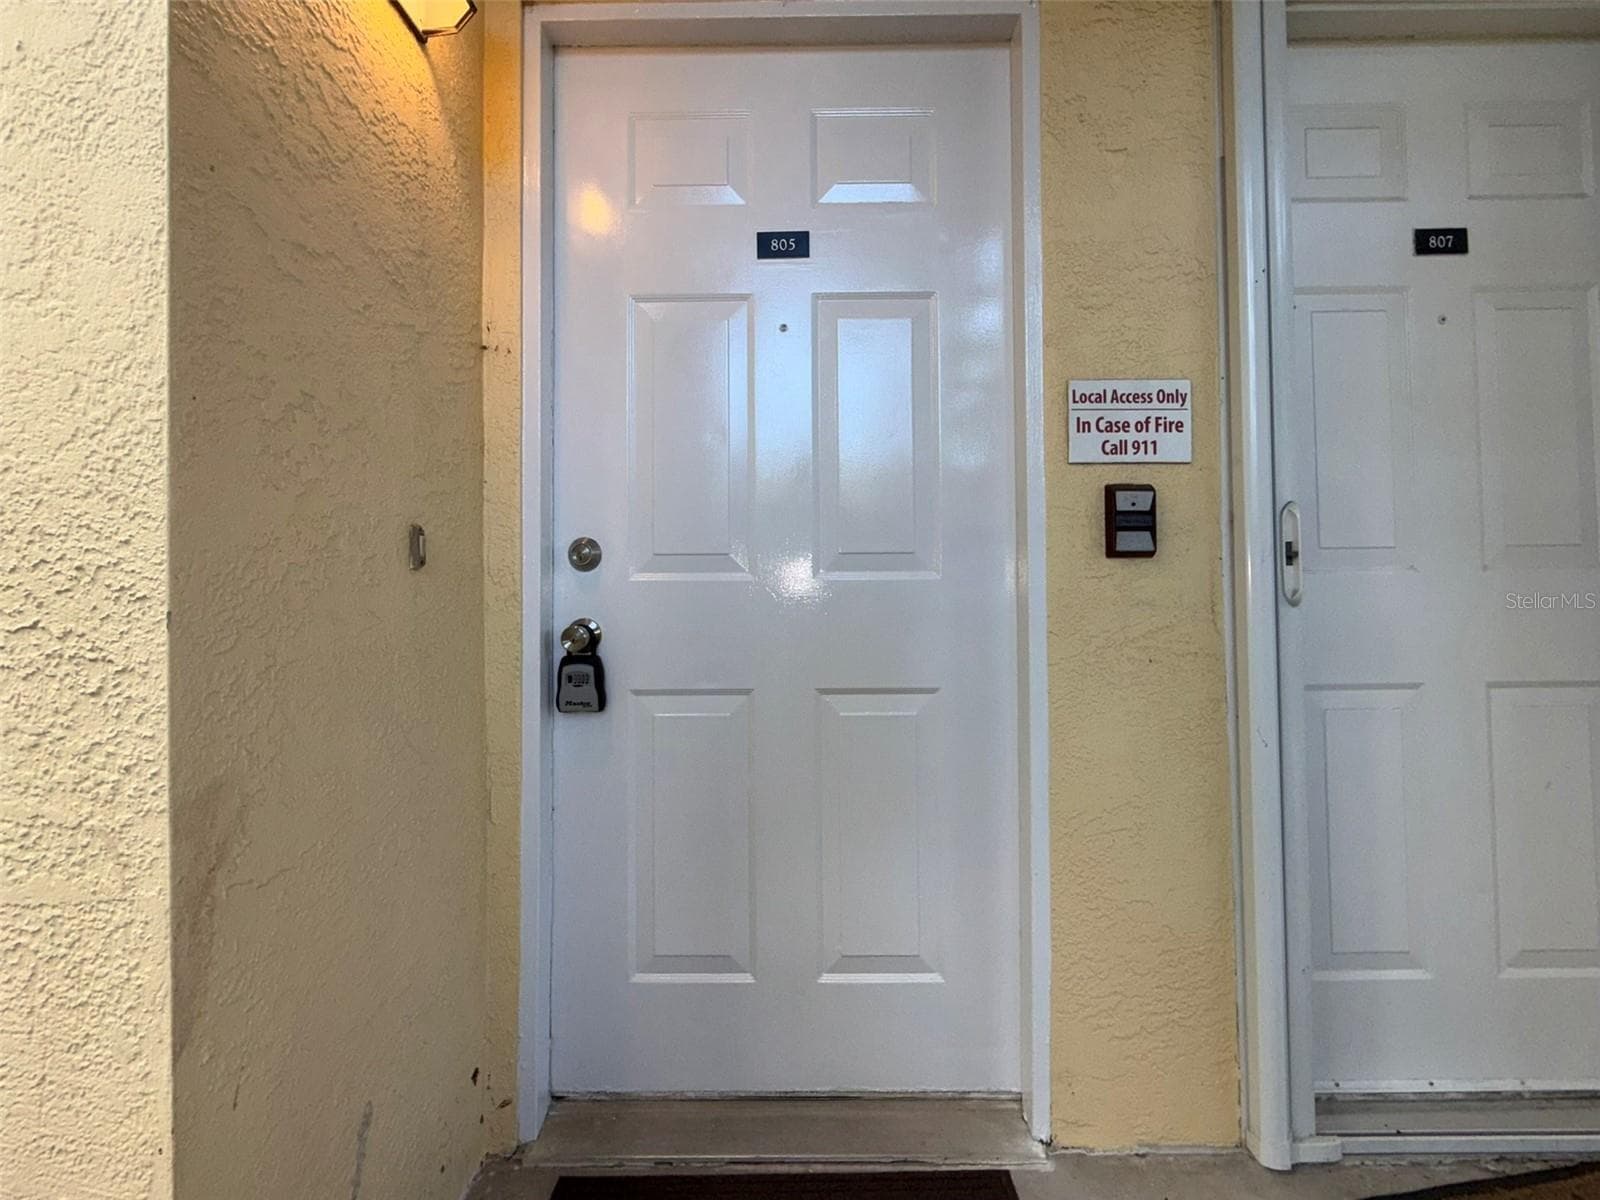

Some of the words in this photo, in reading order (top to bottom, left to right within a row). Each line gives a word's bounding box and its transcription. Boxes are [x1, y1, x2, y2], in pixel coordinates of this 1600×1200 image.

[770, 238, 796, 251] 805
[1428, 235, 1454, 249] 807
[1072, 389, 1107, 404] Local
[1110, 389, 1153, 404] Access
[1156, 389, 1188, 407] Only
[1076, 417, 1091, 433] In
[1095, 417, 1131, 433] Case
[1134, 416, 1152, 433] of
[1154, 417, 1184, 433] Fire
[1101, 440, 1128, 455] Call
[1132, 440, 1158, 455] 911
